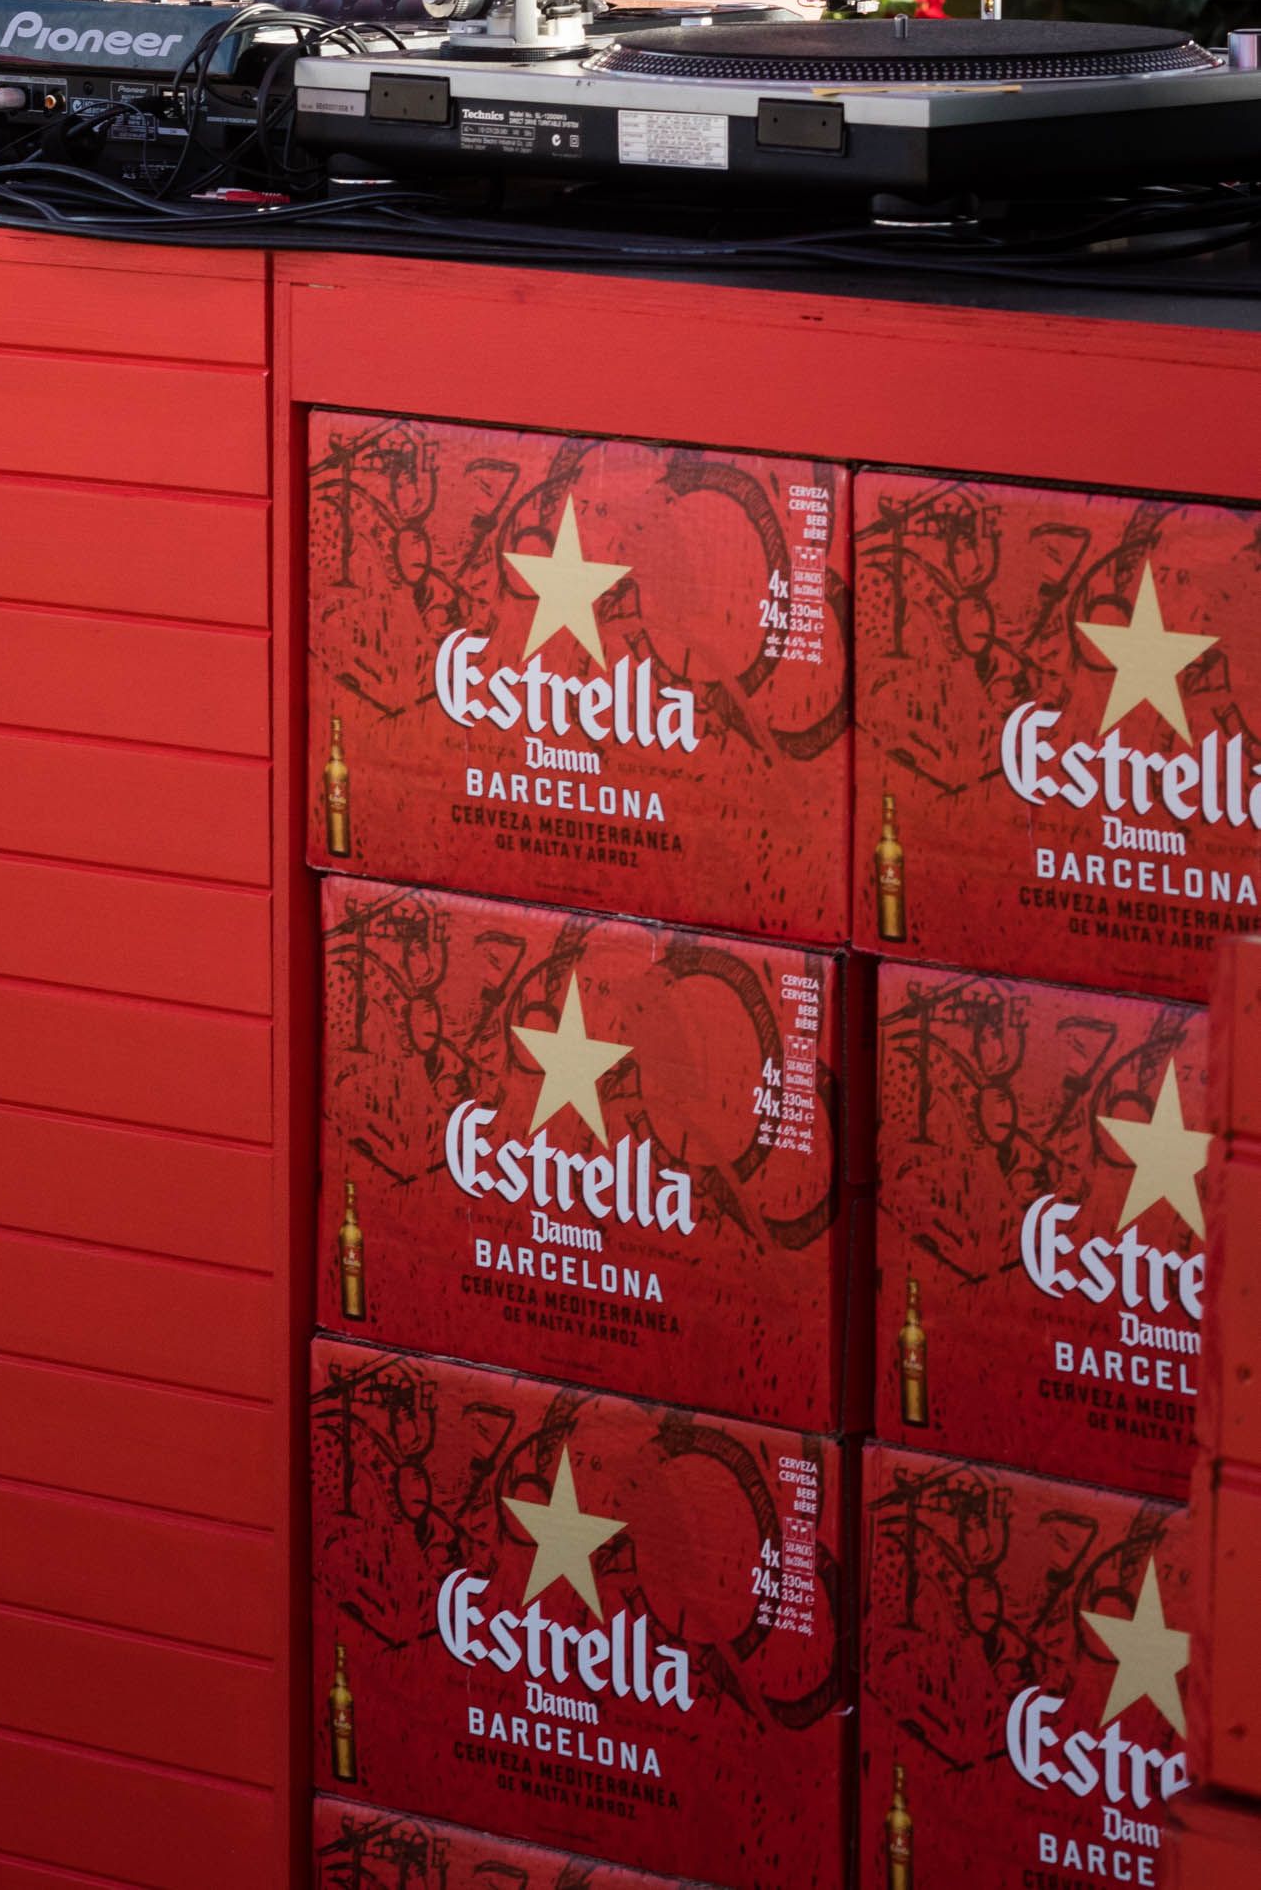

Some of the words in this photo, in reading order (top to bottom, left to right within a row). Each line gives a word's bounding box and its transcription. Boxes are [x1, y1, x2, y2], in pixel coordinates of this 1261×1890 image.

[0, 11, 183, 57] Pioneer
[461, 109, 505, 121] Technics
[789, 485, 829, 500] CERVEZA
[789, 499, 828, 512] CERVESA
[806, 515, 827, 527] BEER
[768, 569, 788, 599] 4x
[759, 599, 788, 630] 24x
[435, 628, 699, 752] Estrella
[524, 736, 601, 775] Damm
[466, 768, 665, 822] BARCELONA
[451, 805, 532, 831] CERVEZA
[496, 833, 515, 850] DE
[520, 836, 570, 858] MALTA
[573, 843, 585, 859] Y
[585, 846, 639, 868] ARROZ
[1101, 815, 1186, 857] Damm
[1037, 848, 1258, 906] BARCELONA
[1019, 886, 1109, 917] CERVEZA
[1095, 921, 1152, 943] MALTA
[1155, 929, 1165, 945] Y
[781, 974, 820, 991] CERVEZA
[781, 988, 819, 1004] CERVESA
[798, 1004, 819, 1018] BEER
[762, 1057, 782, 1087] 4x
[753, 1086, 781, 1118] 24x
[445, 1099, 695, 1236] Estrella
[530, 1210, 604, 1253] Damm
[475, 1238, 663, 1303] BARCELONA
[1021, 1193, 1204, 1320] Estre
[460, 1275, 537, 1305] CERVEZA
[503, 1305, 521, 1323] DE
[526, 1310, 573, 1333] MALTA
[575, 1320, 586, 1335] Y
[589, 1323, 639, 1347] ARROZ
[1118, 1310, 1201, 1355] Damm
[1055, 1341, 1198, 1395] BARCEL
[1040, 1379, 1127, 1413] CERVEZA
[1114, 1417, 1170, 1441] MALTA
[778, 1457, 818, 1474] CERVEZA
[778, 1470, 817, 1487] CERVESA
[796, 1487, 817, 1500] BEER
[760, 1538, 780, 1568] 4x
[751, 1567, 779, 1599] 24x
[437, 1568, 694, 1712] Estrella
[524, 1680, 599, 1726] Damm
[454, 1741, 532, 1775] CERVEZA
[468, 1707, 661, 1778] BARCELONA
[1006, 1685, 1191, 1810] Estre
[497, 1773, 514, 1792] DE
[521, 1779, 568, 1805] MALTA
[572, 1791, 583, 1807] Y
[585, 1796, 636, 1821] ARROZ
[1101, 1805, 1160, 1849] Dam
[1039, 1832, 1155, 1887] BARCE
